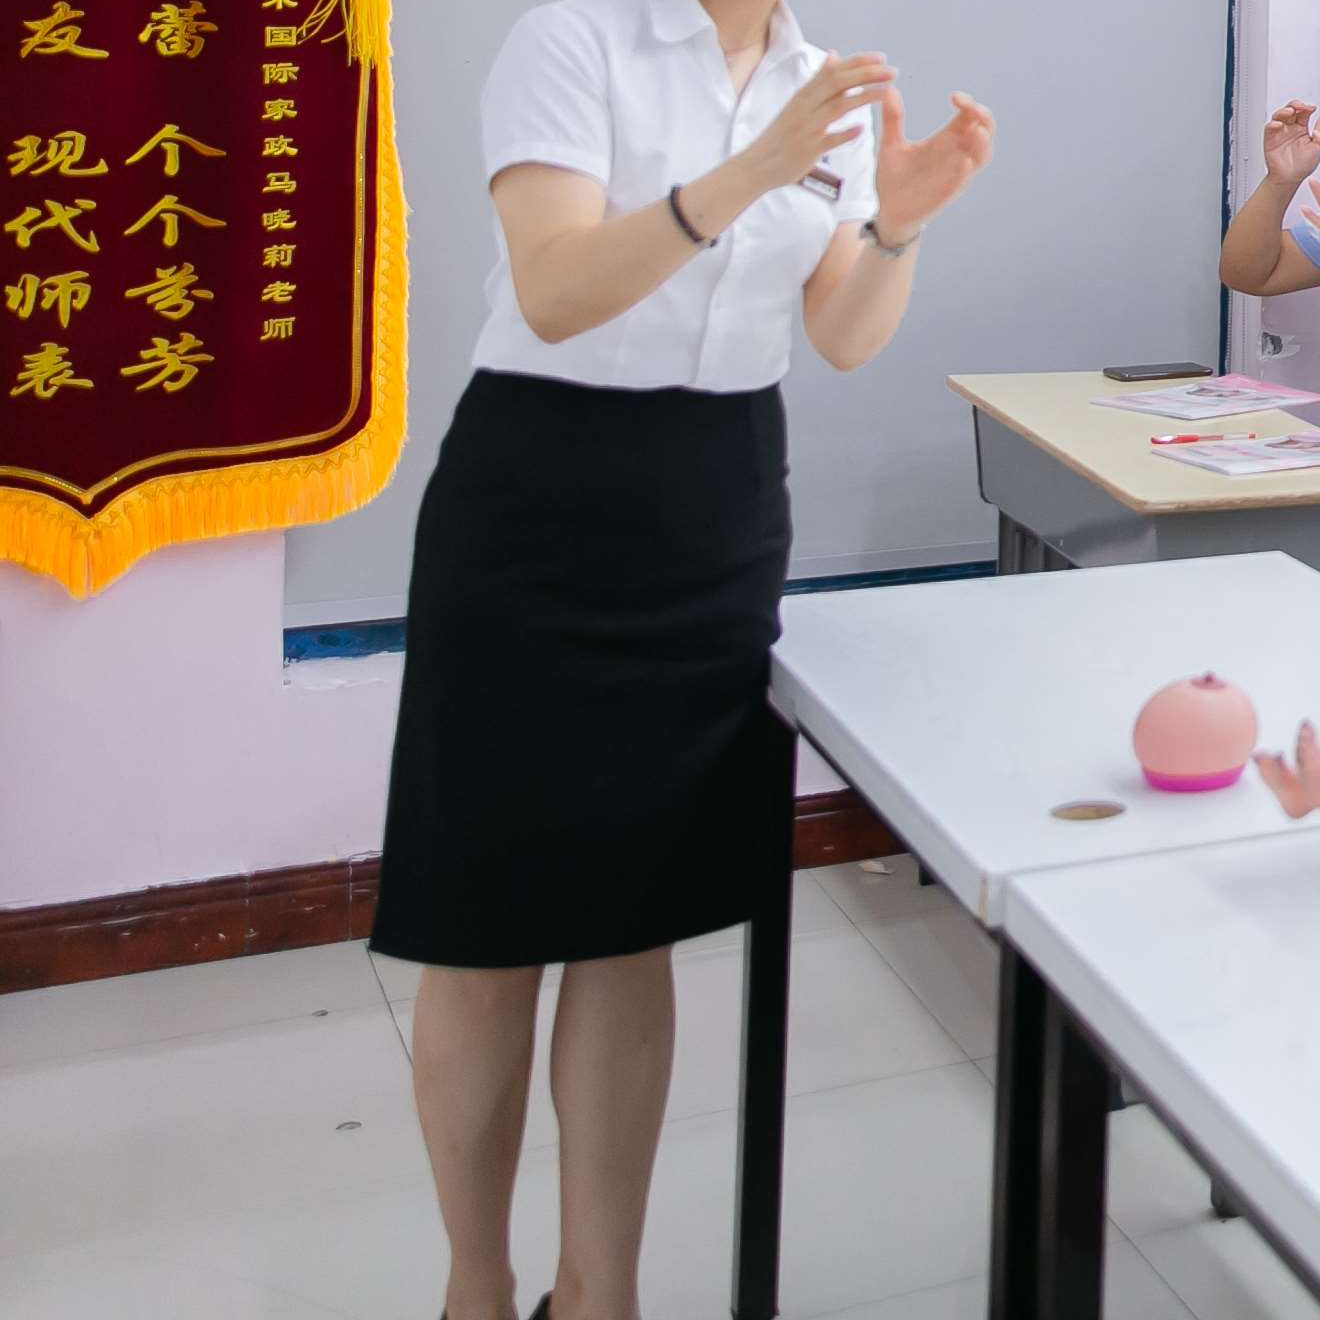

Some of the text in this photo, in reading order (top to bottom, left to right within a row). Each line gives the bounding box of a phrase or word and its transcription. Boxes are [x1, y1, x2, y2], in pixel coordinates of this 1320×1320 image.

[4, 130, 109, 399] 现代师表
[120, 123, 227, 393] 个个芬芳
